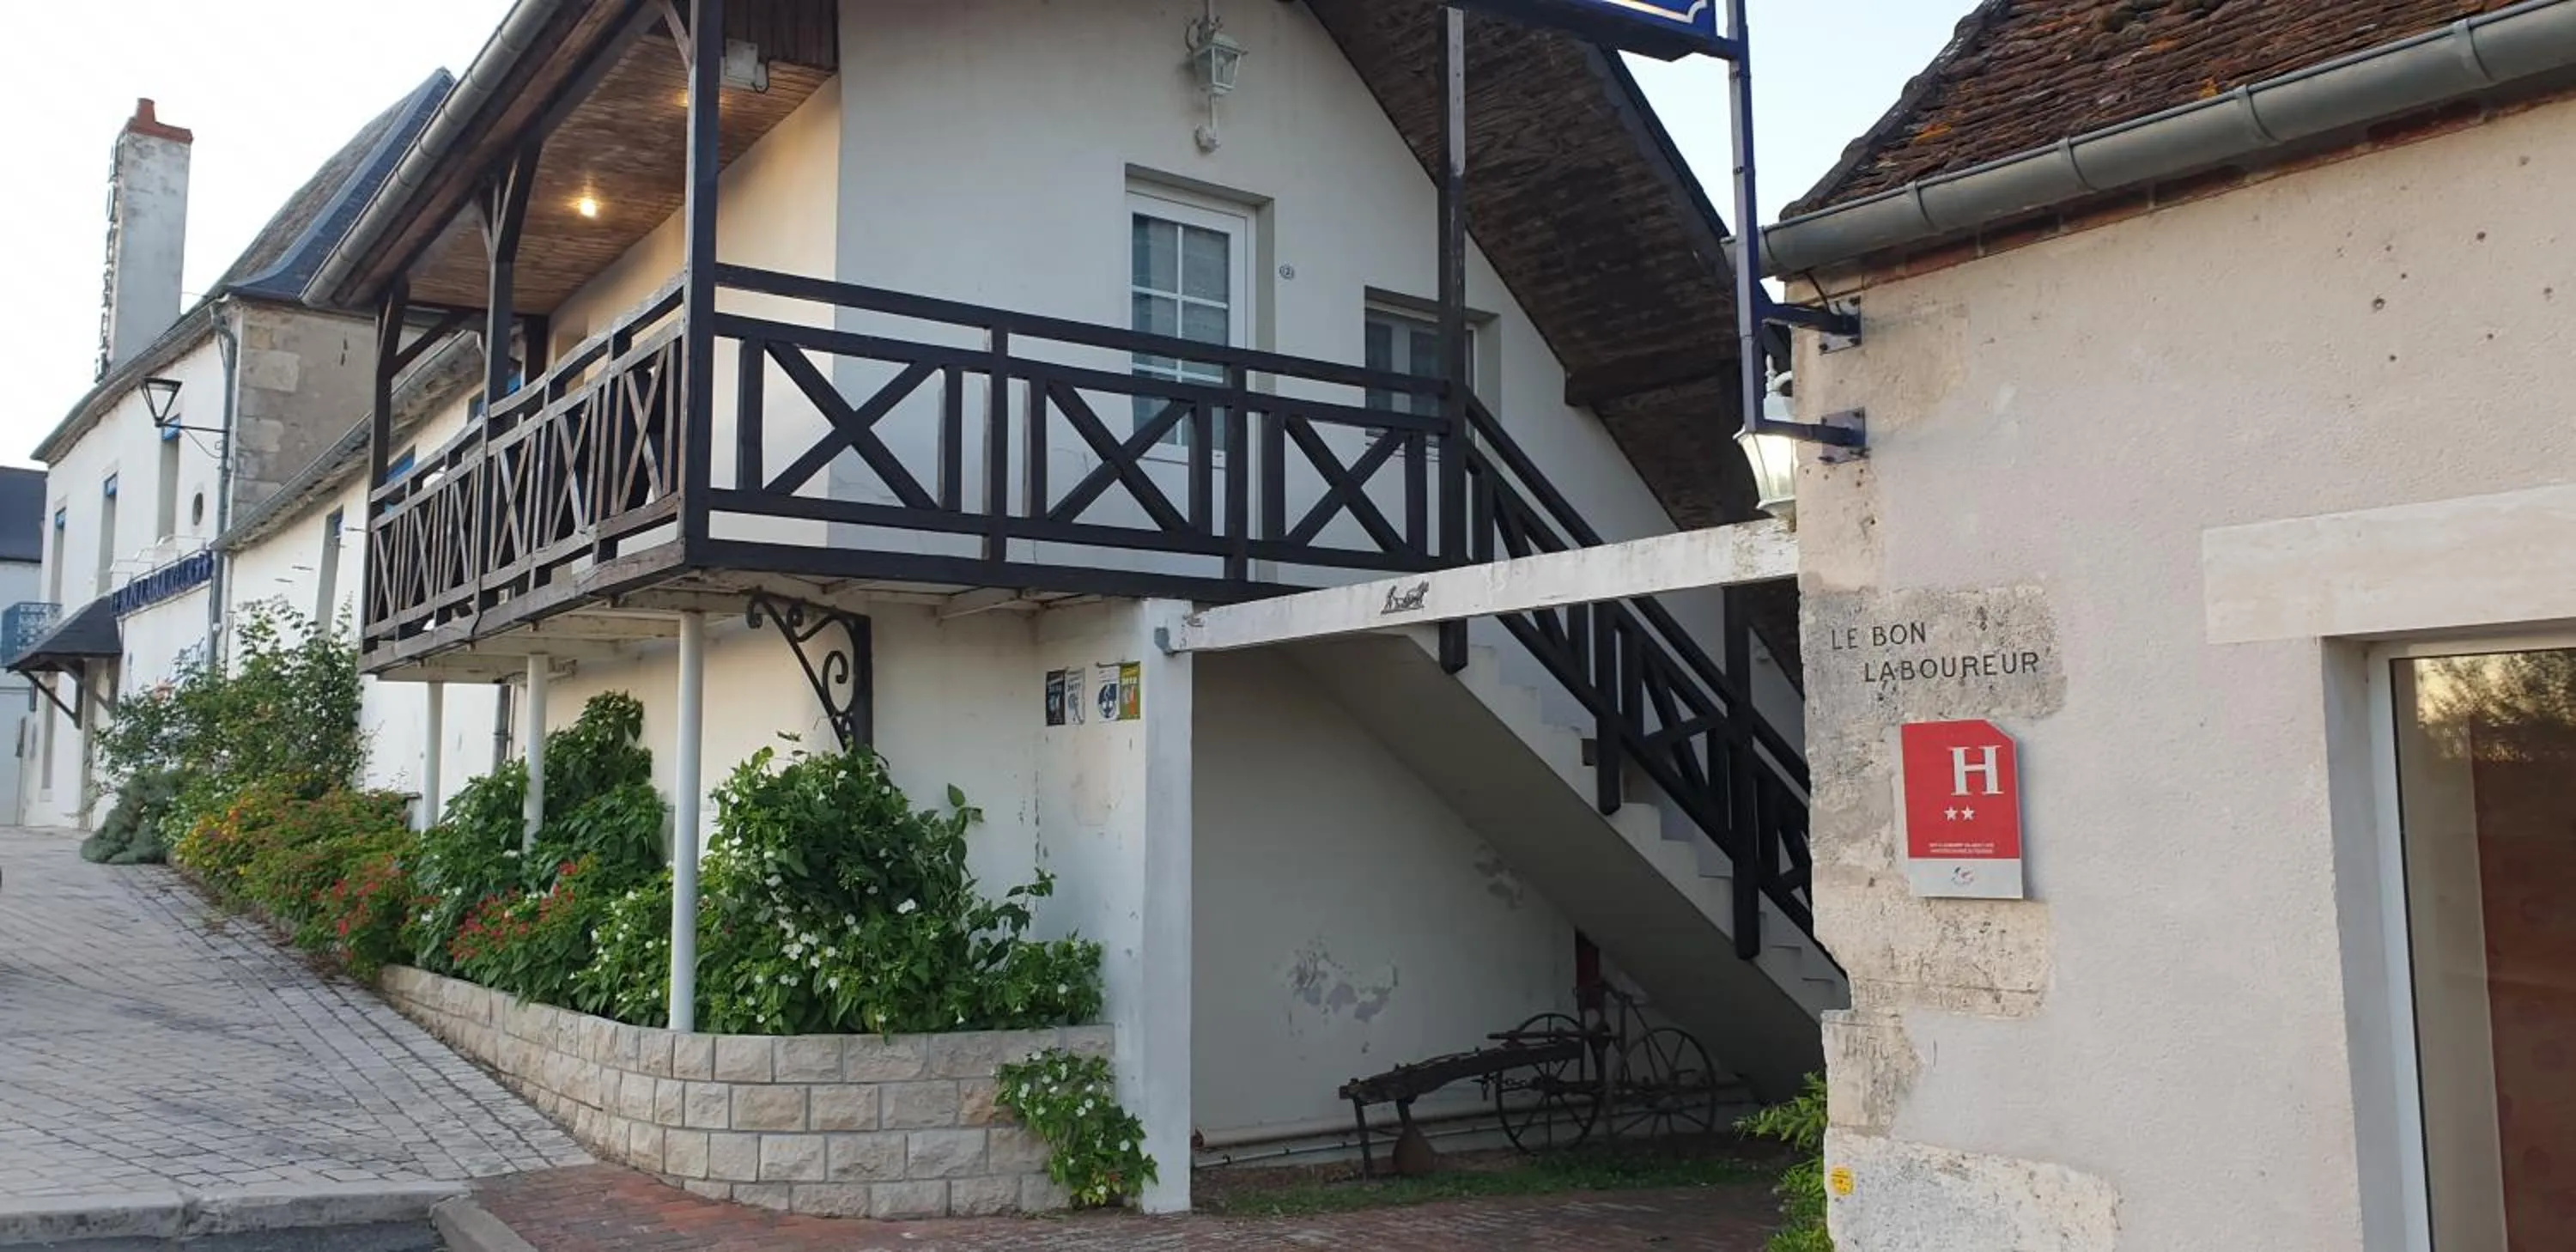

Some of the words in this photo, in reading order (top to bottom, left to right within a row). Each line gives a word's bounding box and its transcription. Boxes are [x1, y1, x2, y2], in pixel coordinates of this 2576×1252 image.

[1831, 628, 1859, 650] LE
[1872, 622, 1926, 647] BON
[1864, 651, 2039, 683] LABOUREUR
[1947, 744, 2005, 796] H
